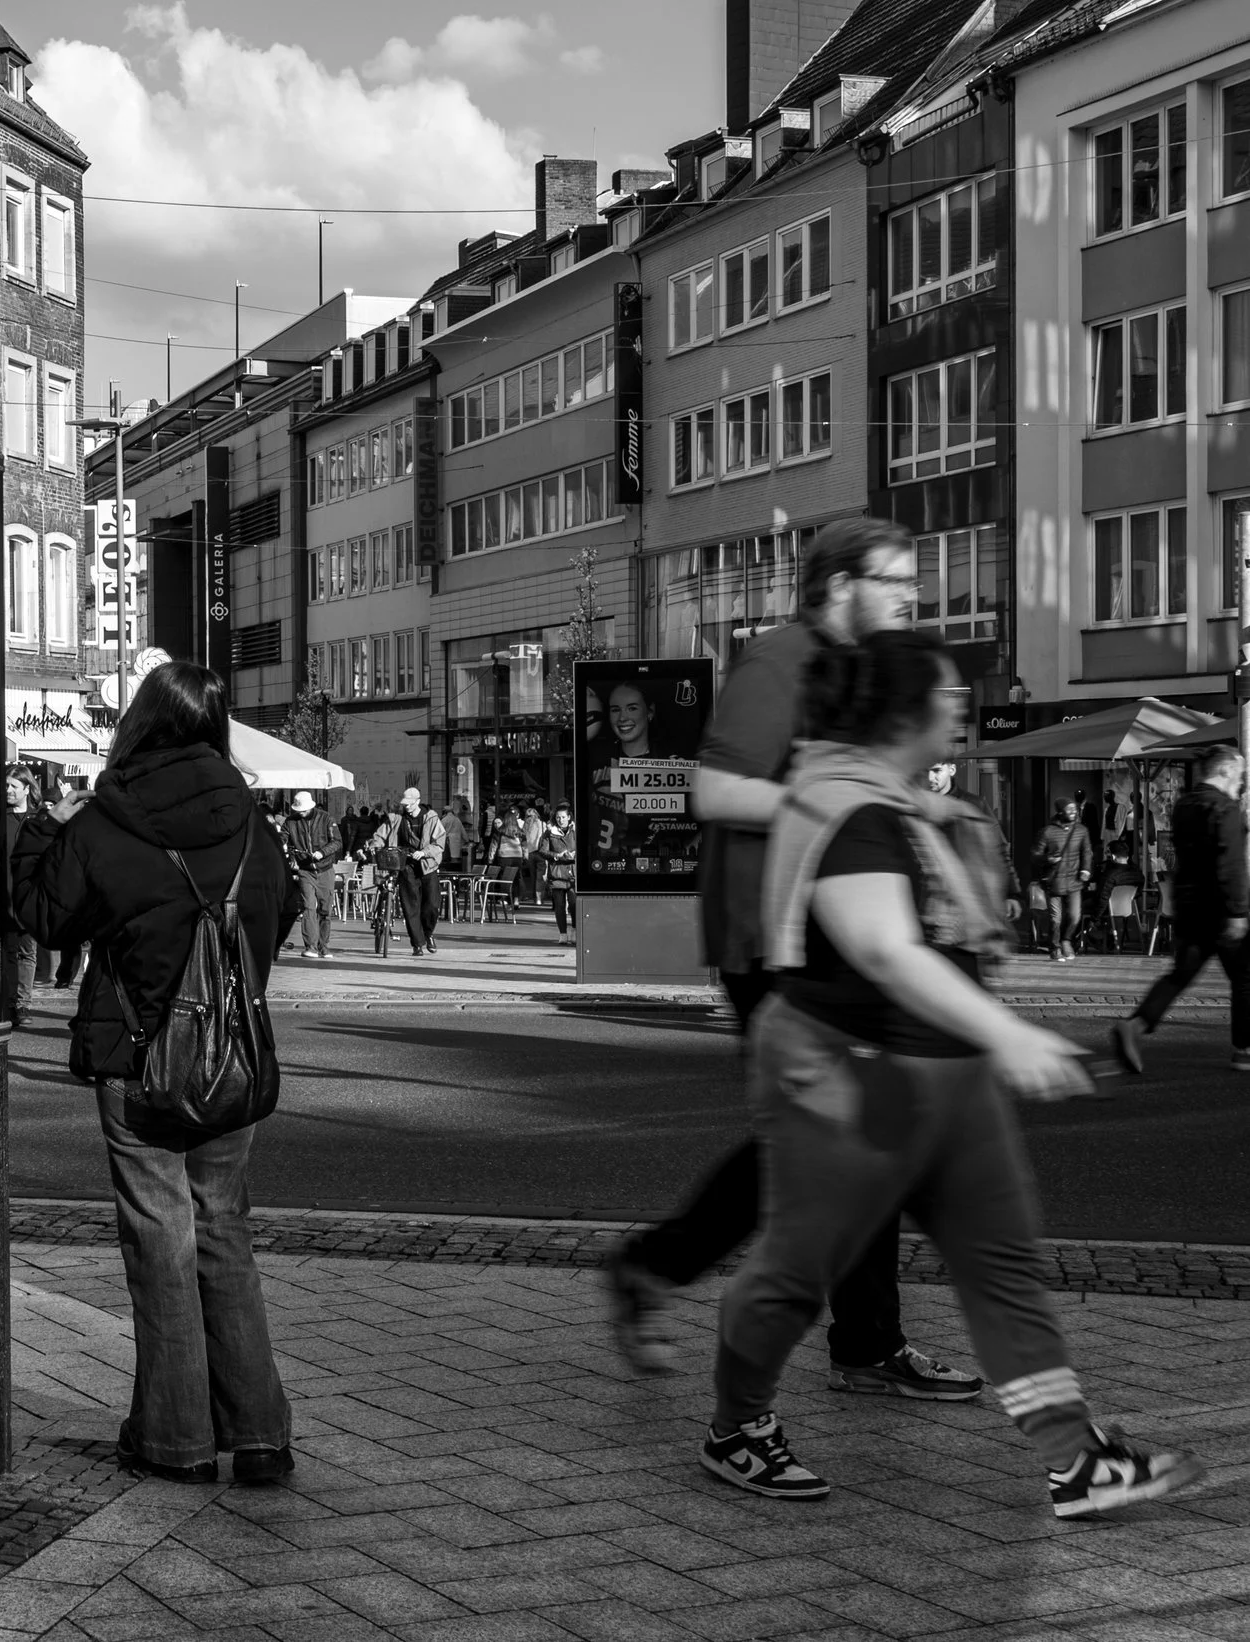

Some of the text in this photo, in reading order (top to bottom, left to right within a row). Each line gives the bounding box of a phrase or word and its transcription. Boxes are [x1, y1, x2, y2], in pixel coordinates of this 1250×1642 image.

[214, 533, 224, 597] GALERIA
[16, 701, 73, 738] ofenfrisch
[986, 717, 1020, 728] s.Oliver
[620, 773, 690, 787] MI 25.03.
[598, 796, 625, 810] STAW
[632, 798, 678, 809] 20.00 h
[598, 819, 614, 850] 3
